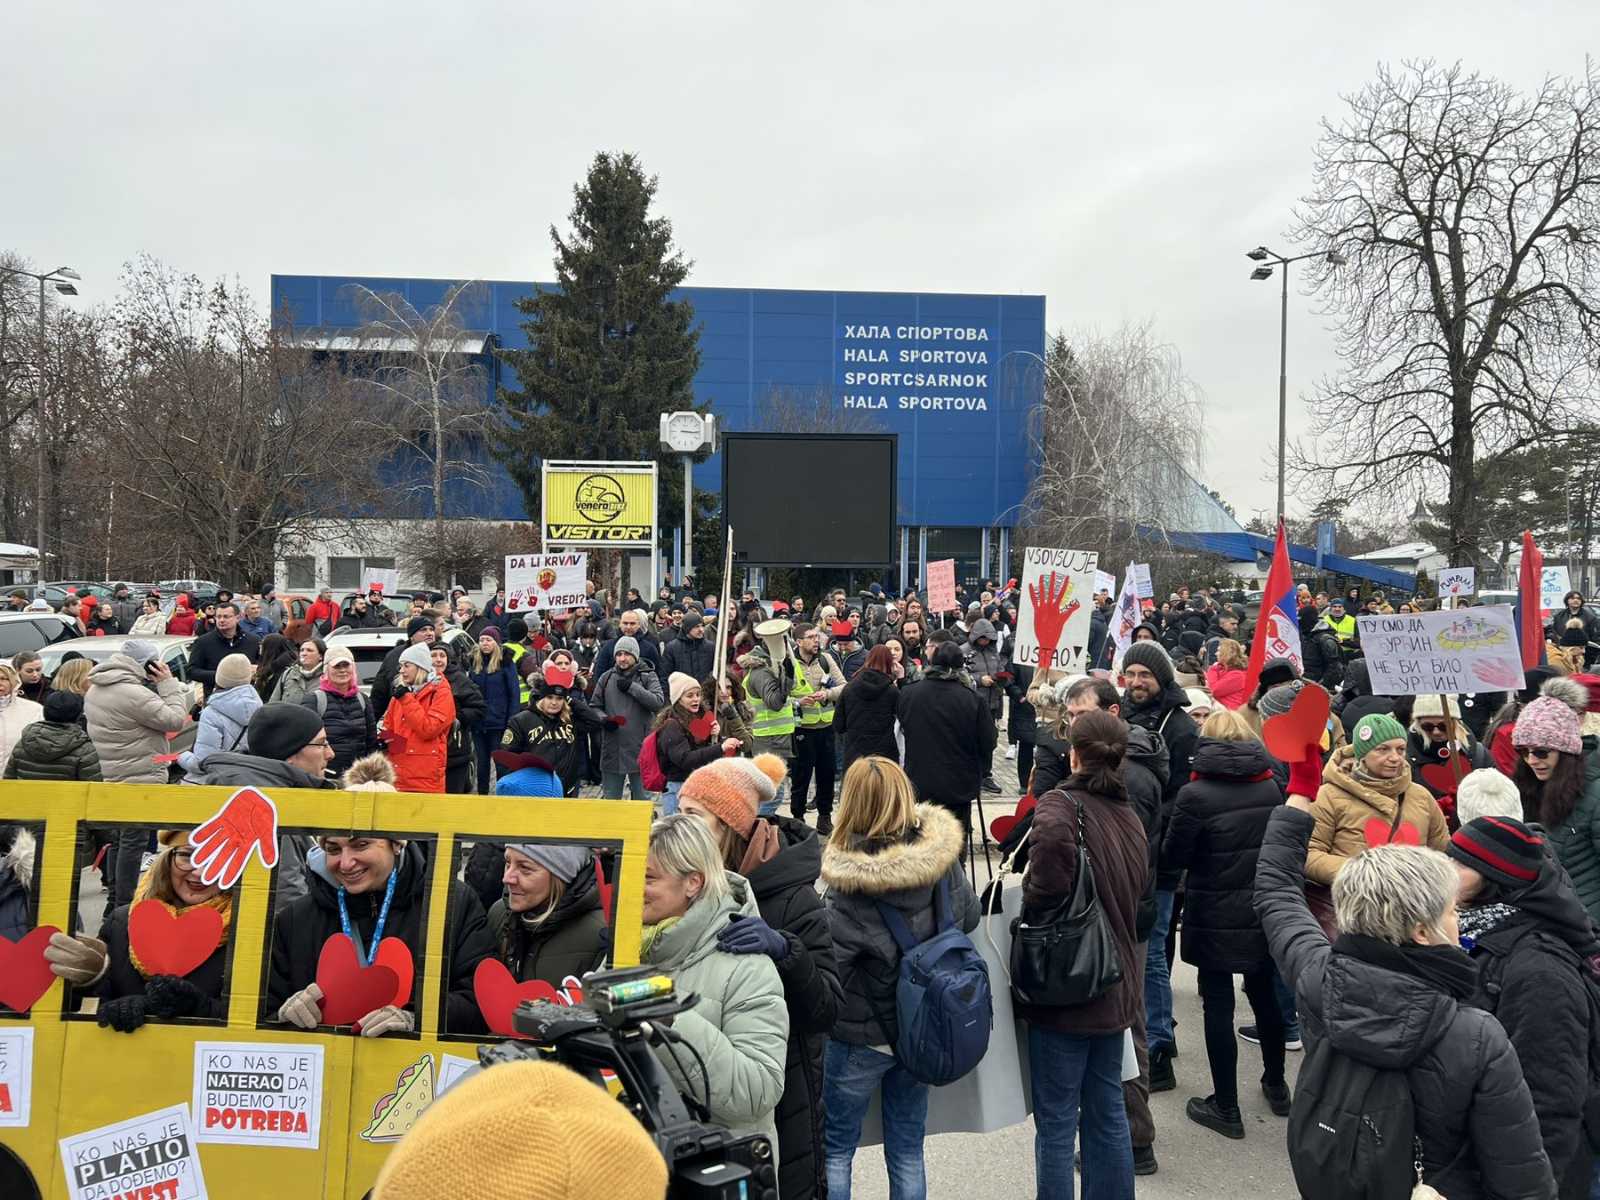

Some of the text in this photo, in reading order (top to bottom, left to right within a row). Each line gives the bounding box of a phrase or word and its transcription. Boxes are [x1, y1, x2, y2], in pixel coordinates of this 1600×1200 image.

[844, 325, 989, 341] ХАЛА СПОРТОВА
[844, 348, 988, 364] HALA SPORTOVA
[844, 372, 988, 388] SPORTCSARNOK
[843, 395, 987, 411] HALA SPORTOVA
[550, 526, 644, 540] VISITOR
[510, 554, 581, 569] DA LI KRVAV
[548, 594, 585, 606] VREDI?
[1361, 619, 1424, 633] ТУ СМО ДА
[1373, 658, 1462, 674] НЕ БИ БИО
[208, 1055, 309, 1071] KO NAS JE
[207, 1073, 308, 1090] NATERAO DA
[207, 1092, 307, 1110] BUDEMO TU?
[206, 1107, 308, 1132] POTREBA
[77, 1122, 179, 1164] KO NAS JE
[79, 1138, 183, 1186] PLATIO
[109, 1160, 186, 1194] DOĐEMO?
